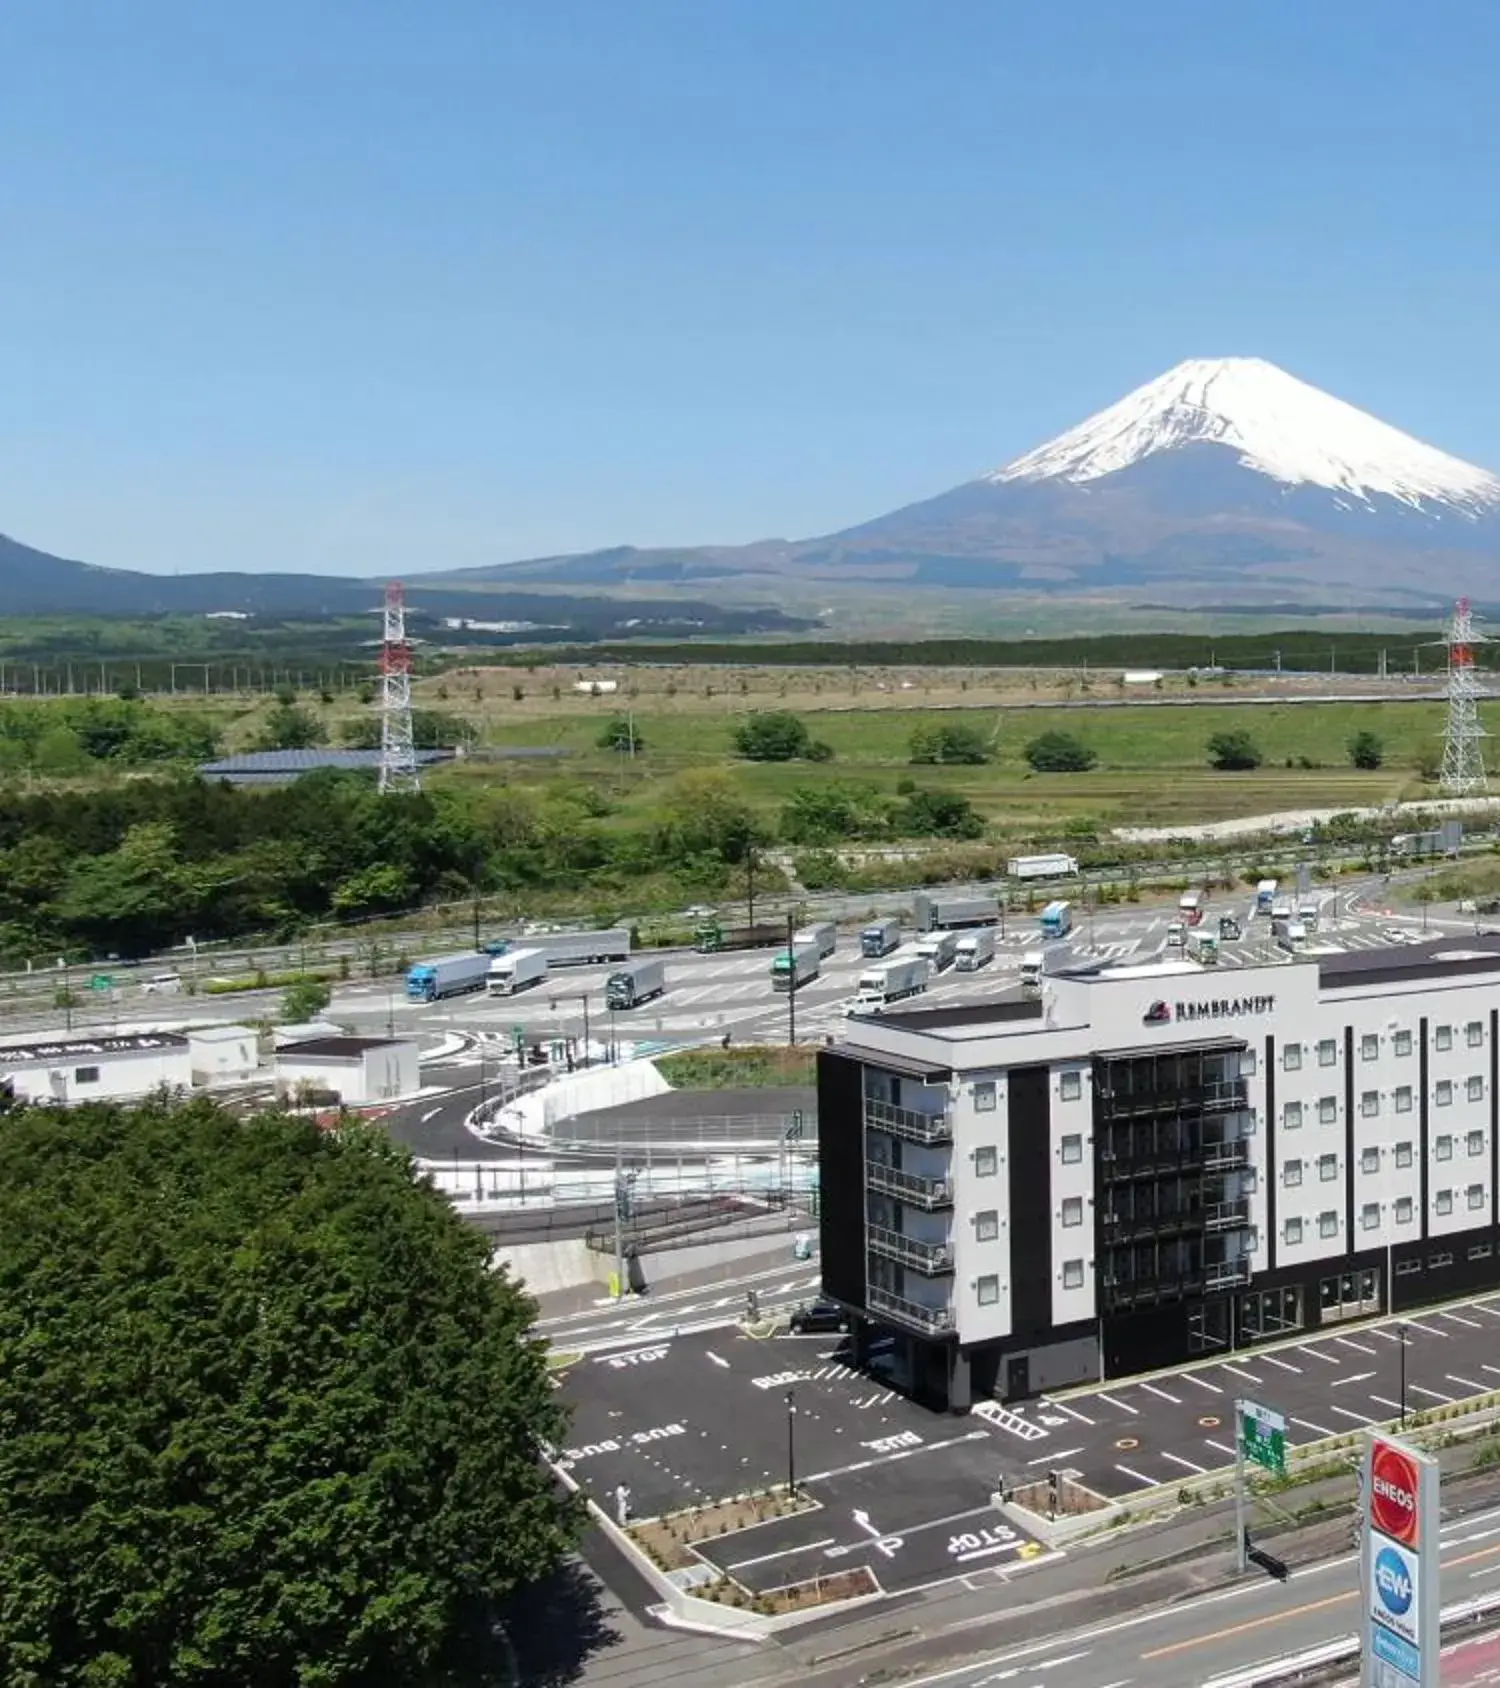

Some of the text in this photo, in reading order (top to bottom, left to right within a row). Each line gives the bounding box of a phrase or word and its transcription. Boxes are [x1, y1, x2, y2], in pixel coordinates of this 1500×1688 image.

[1175, 995, 1276, 1022] REMBRANDT
[608, 1349, 668, 1368] STOP
[752, 1371, 800, 1390] BUS
[564, 1423, 687, 1460] BUS BUS
[1373, 1477, 1414, 1511] ENEOS
[947, 1524, 1017, 1554] STOP
